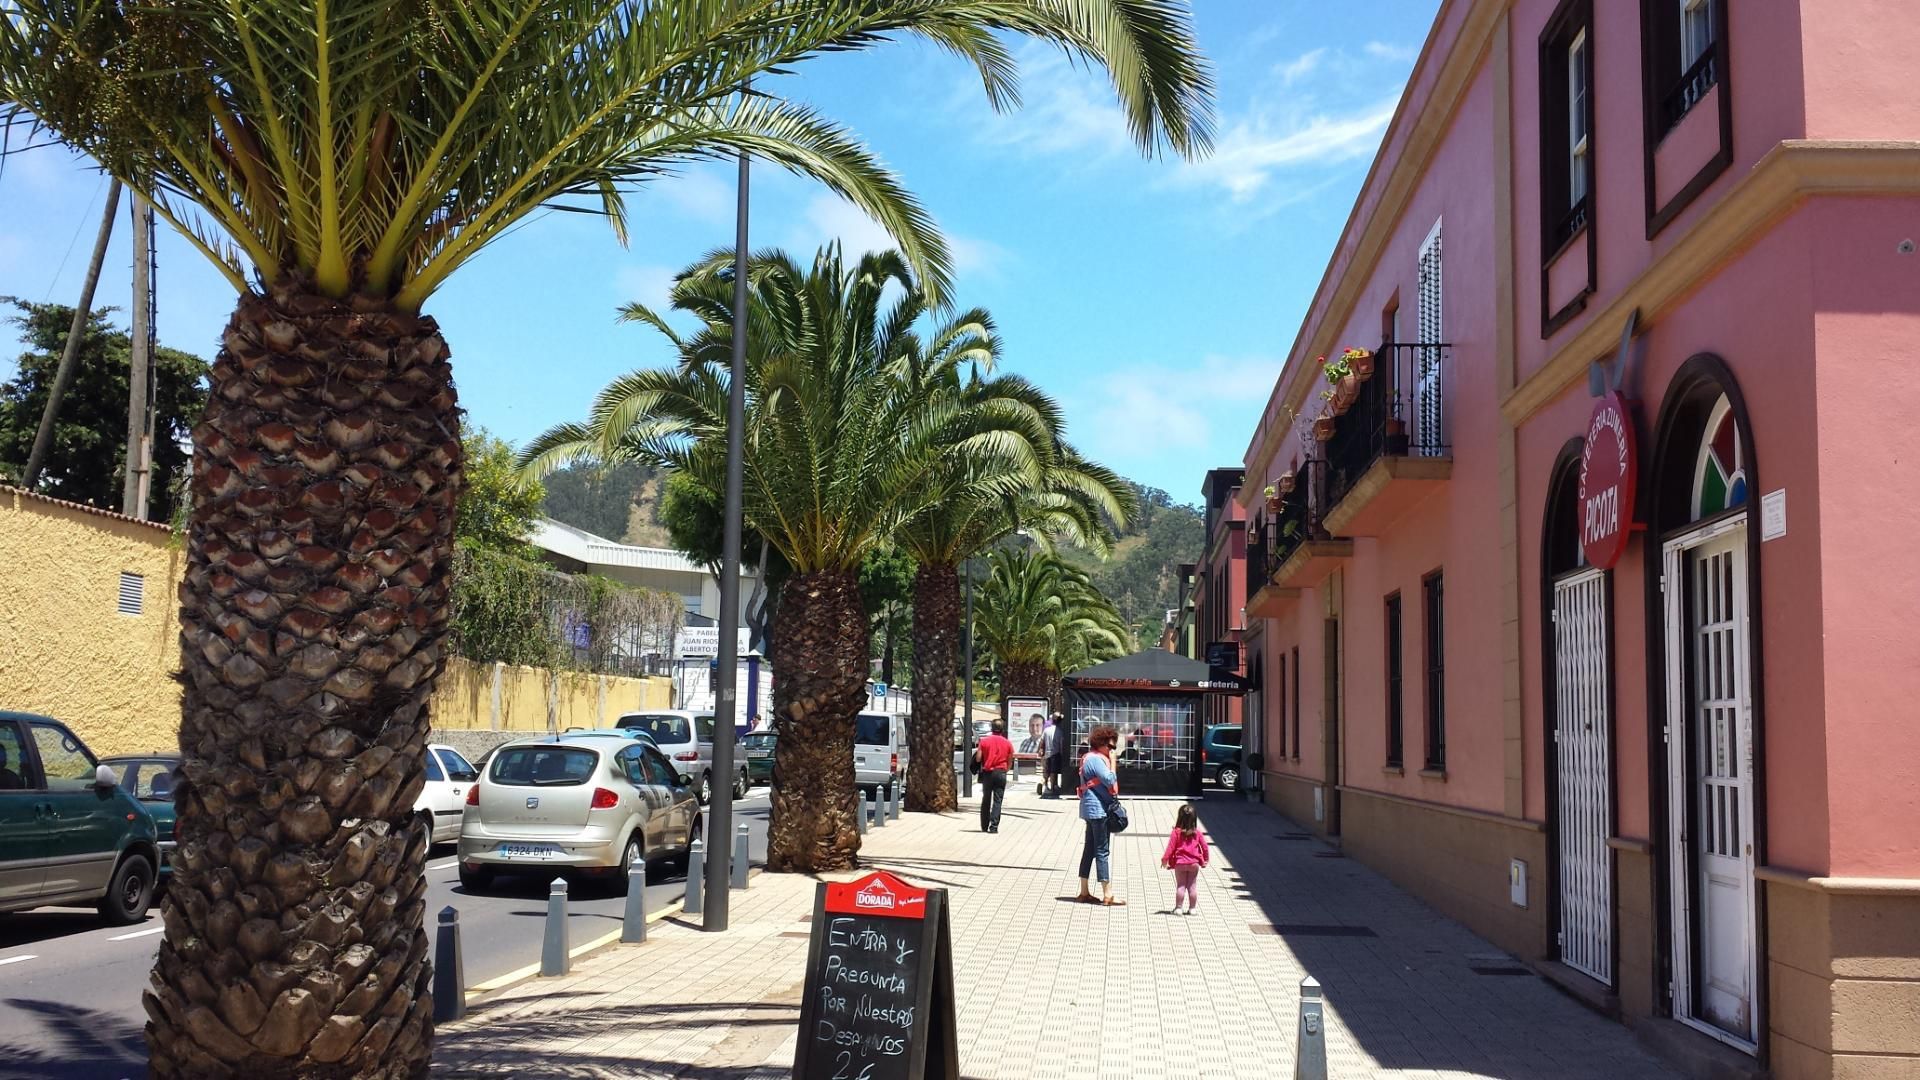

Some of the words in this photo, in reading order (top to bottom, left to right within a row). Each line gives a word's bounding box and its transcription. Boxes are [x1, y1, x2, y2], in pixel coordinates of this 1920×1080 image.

[1584, 484, 1618, 546] PICOTA
[1197, 680, 1239, 689] cafeteria
[507, 845, 531, 856] 6324
[858, 893, 892, 906] DORADA
